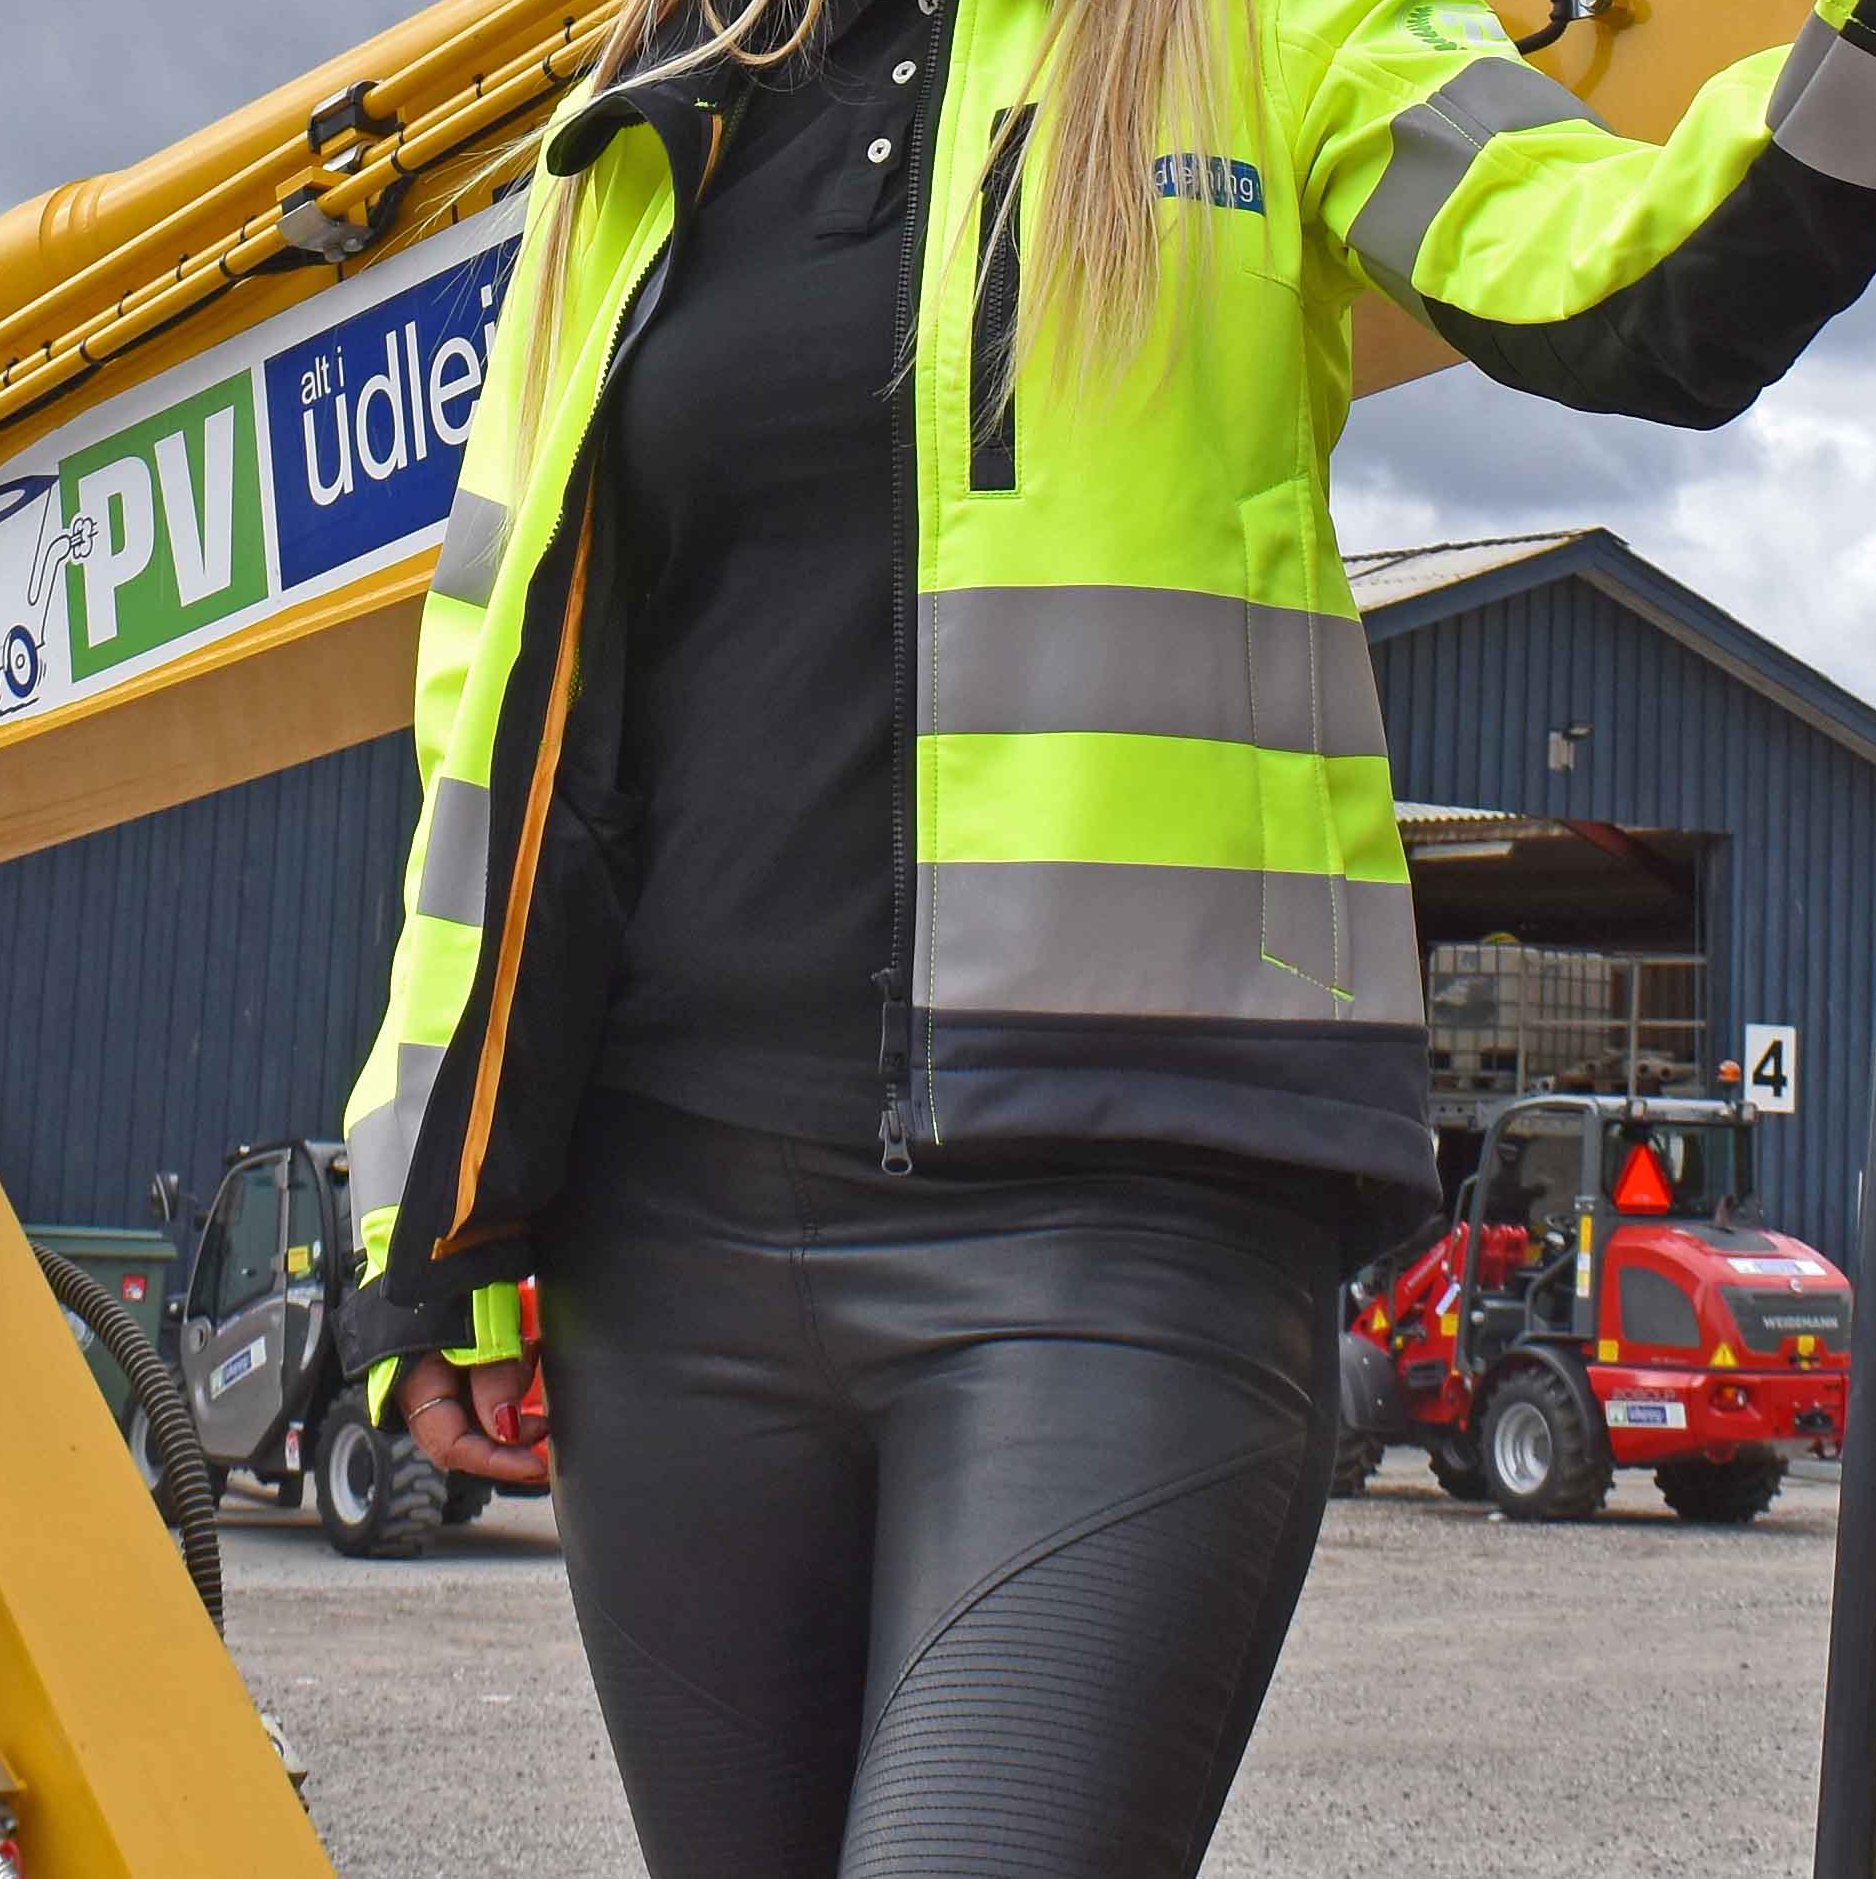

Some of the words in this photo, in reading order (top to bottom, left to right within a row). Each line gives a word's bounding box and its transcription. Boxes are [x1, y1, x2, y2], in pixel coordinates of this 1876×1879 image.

[301, 356, 331, 405] alt
[338, 347, 345, 387] i
[78, 405, 235, 649] PV
[1753, 1040, 1788, 1098] 4
